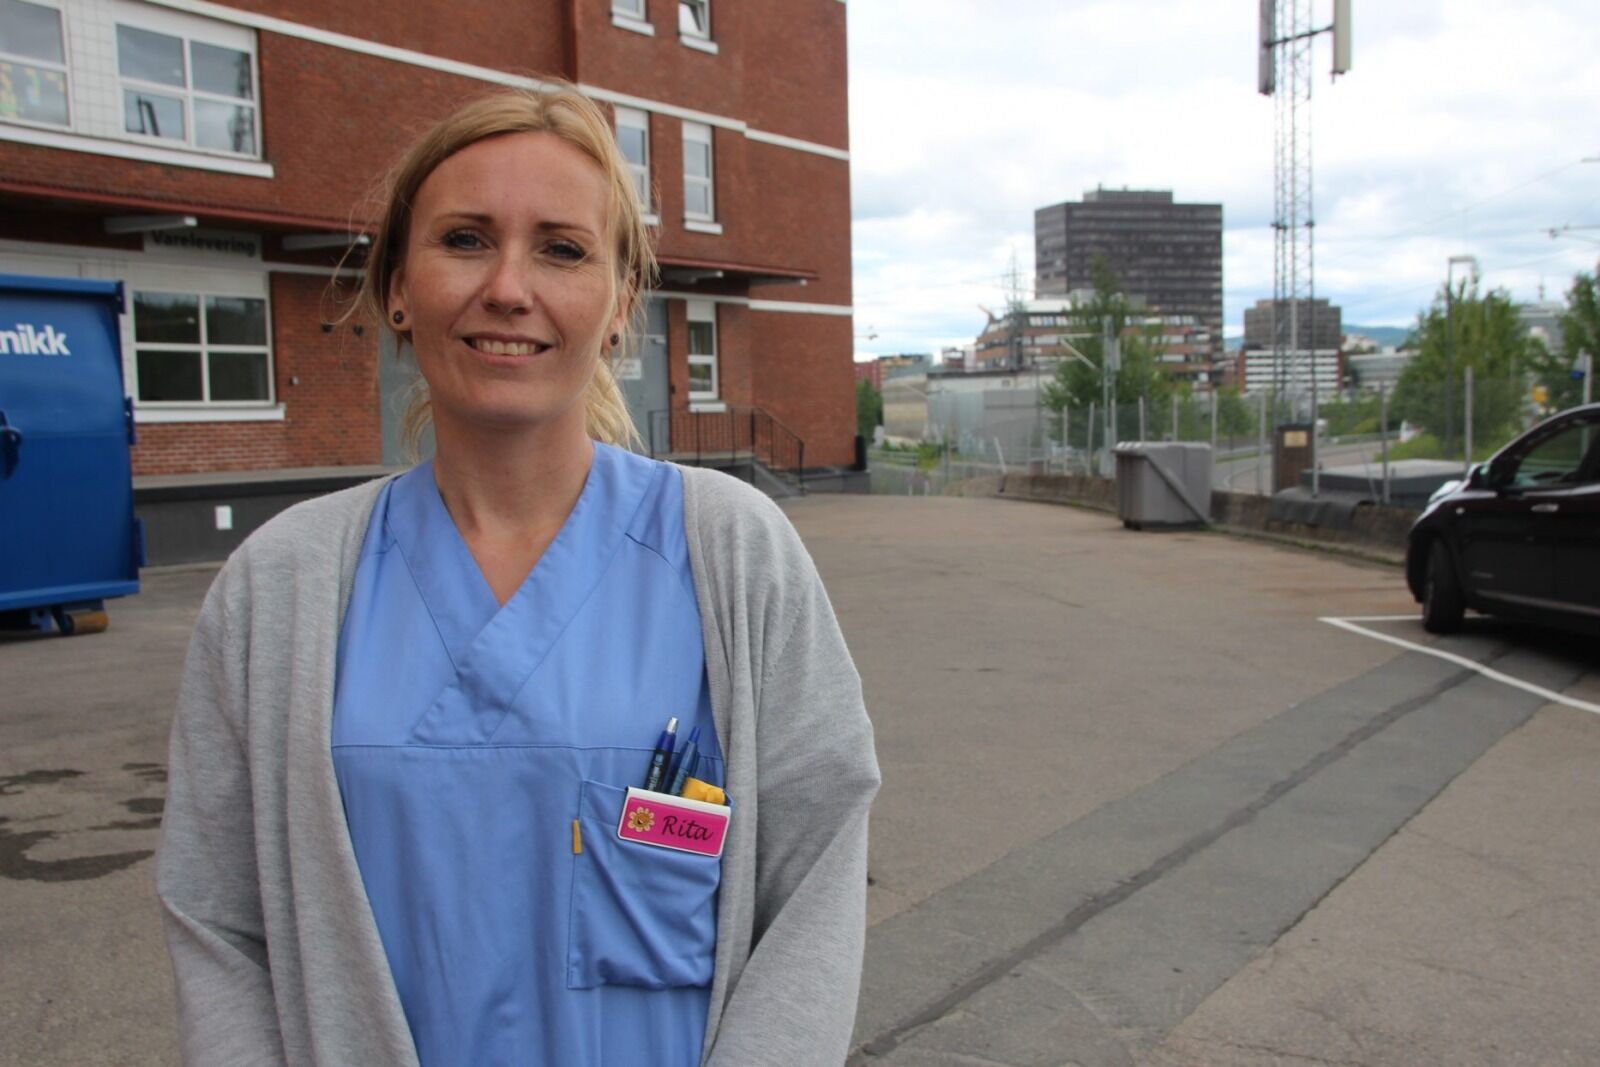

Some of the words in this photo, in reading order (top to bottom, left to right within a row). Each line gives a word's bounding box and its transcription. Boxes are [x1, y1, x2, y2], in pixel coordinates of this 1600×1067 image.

[151, 230, 257, 257] Varelevering
[0, 323, 71, 356] nikk
[661, 815, 713, 841] Rita
